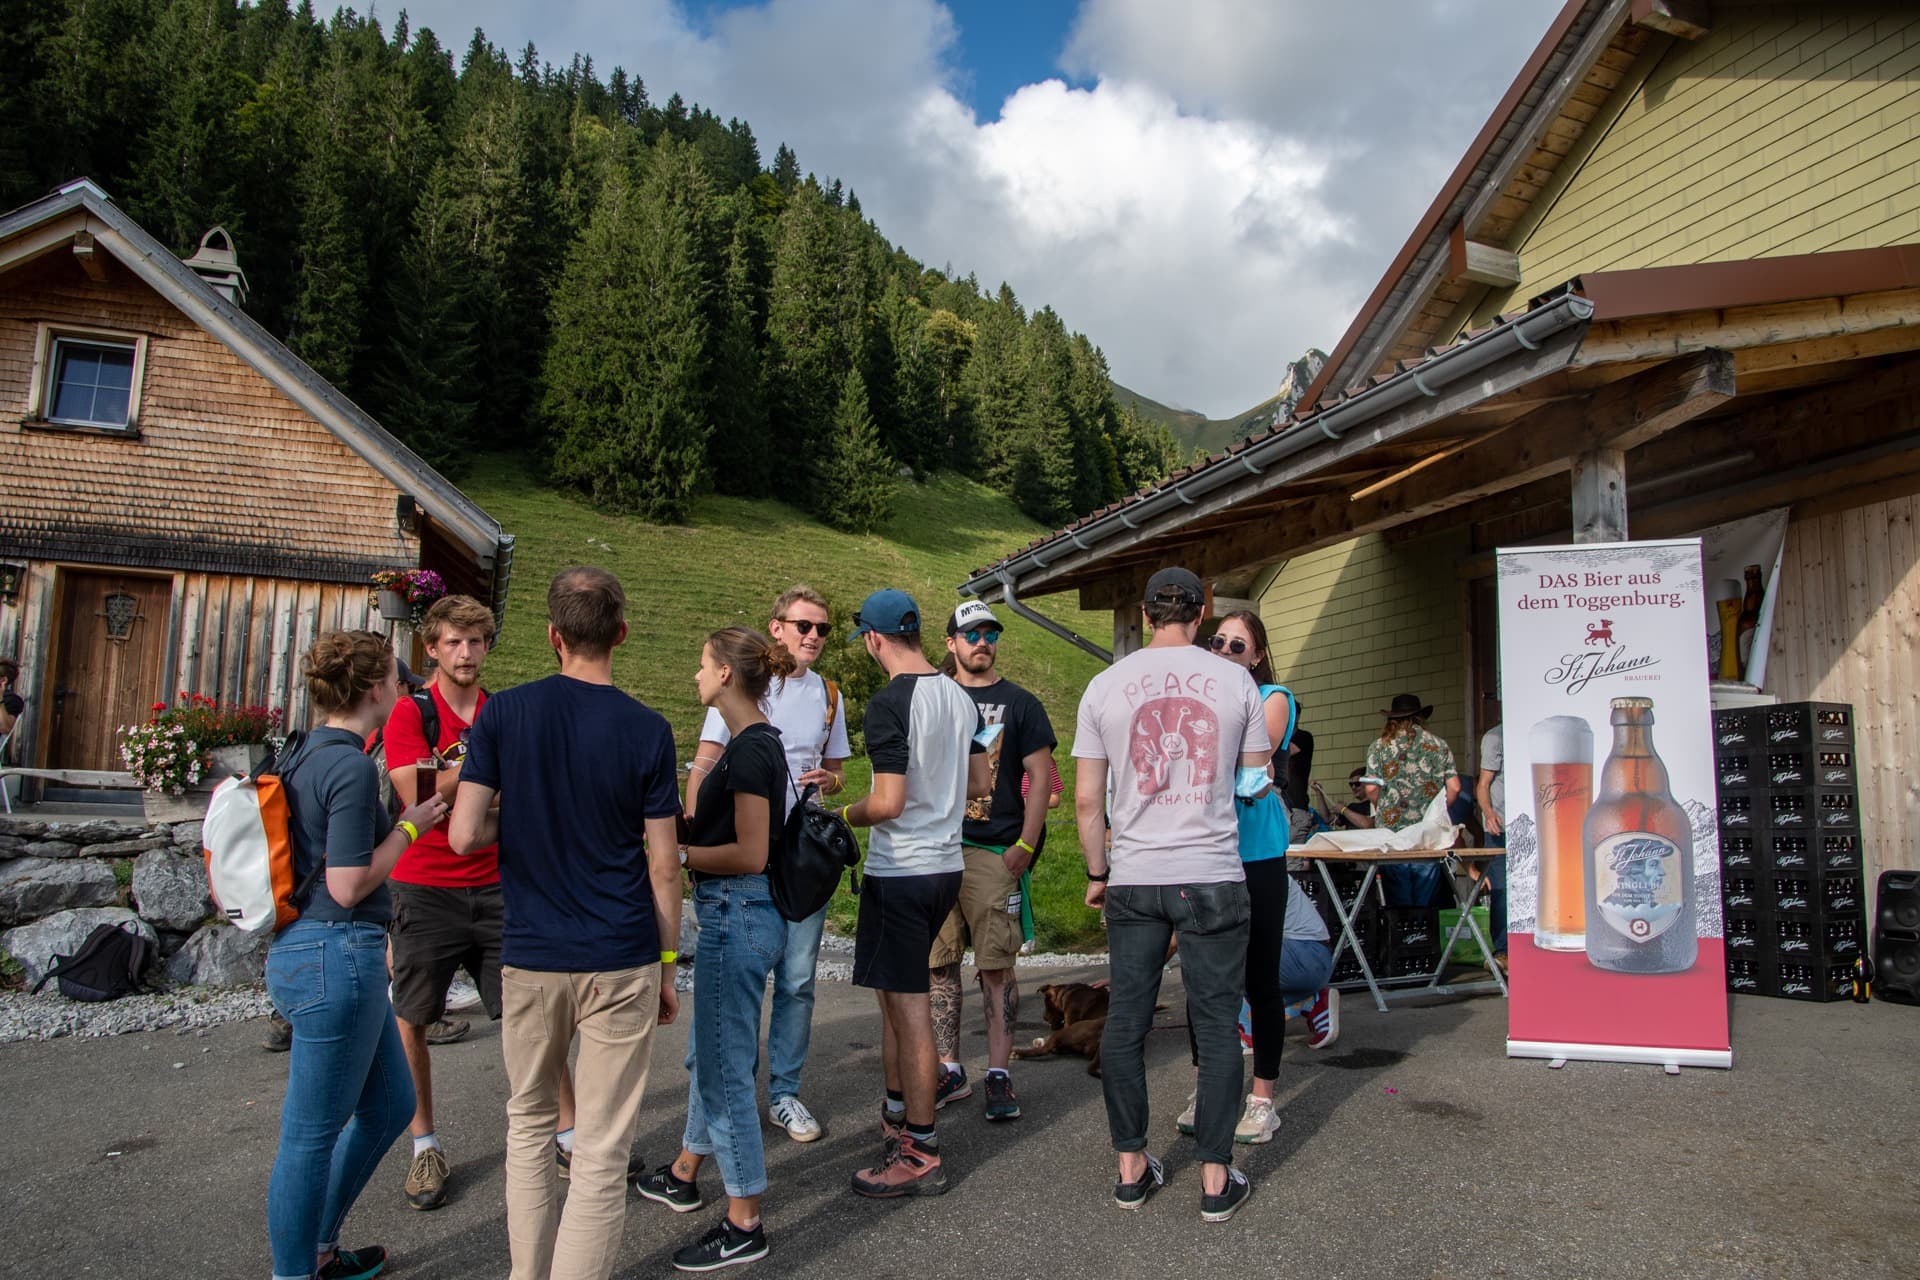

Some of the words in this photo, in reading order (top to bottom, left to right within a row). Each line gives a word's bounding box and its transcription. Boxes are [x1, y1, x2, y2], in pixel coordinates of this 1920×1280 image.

[1539, 573, 1578, 588] DAS
[1584, 572, 1622, 587] Bier
[1628, 573, 1661, 585] aus
[1517, 594, 1558, 610] dem
[1564, 590, 1685, 611] Toggenburg.
[1123, 672, 1217, 709] PEACE
